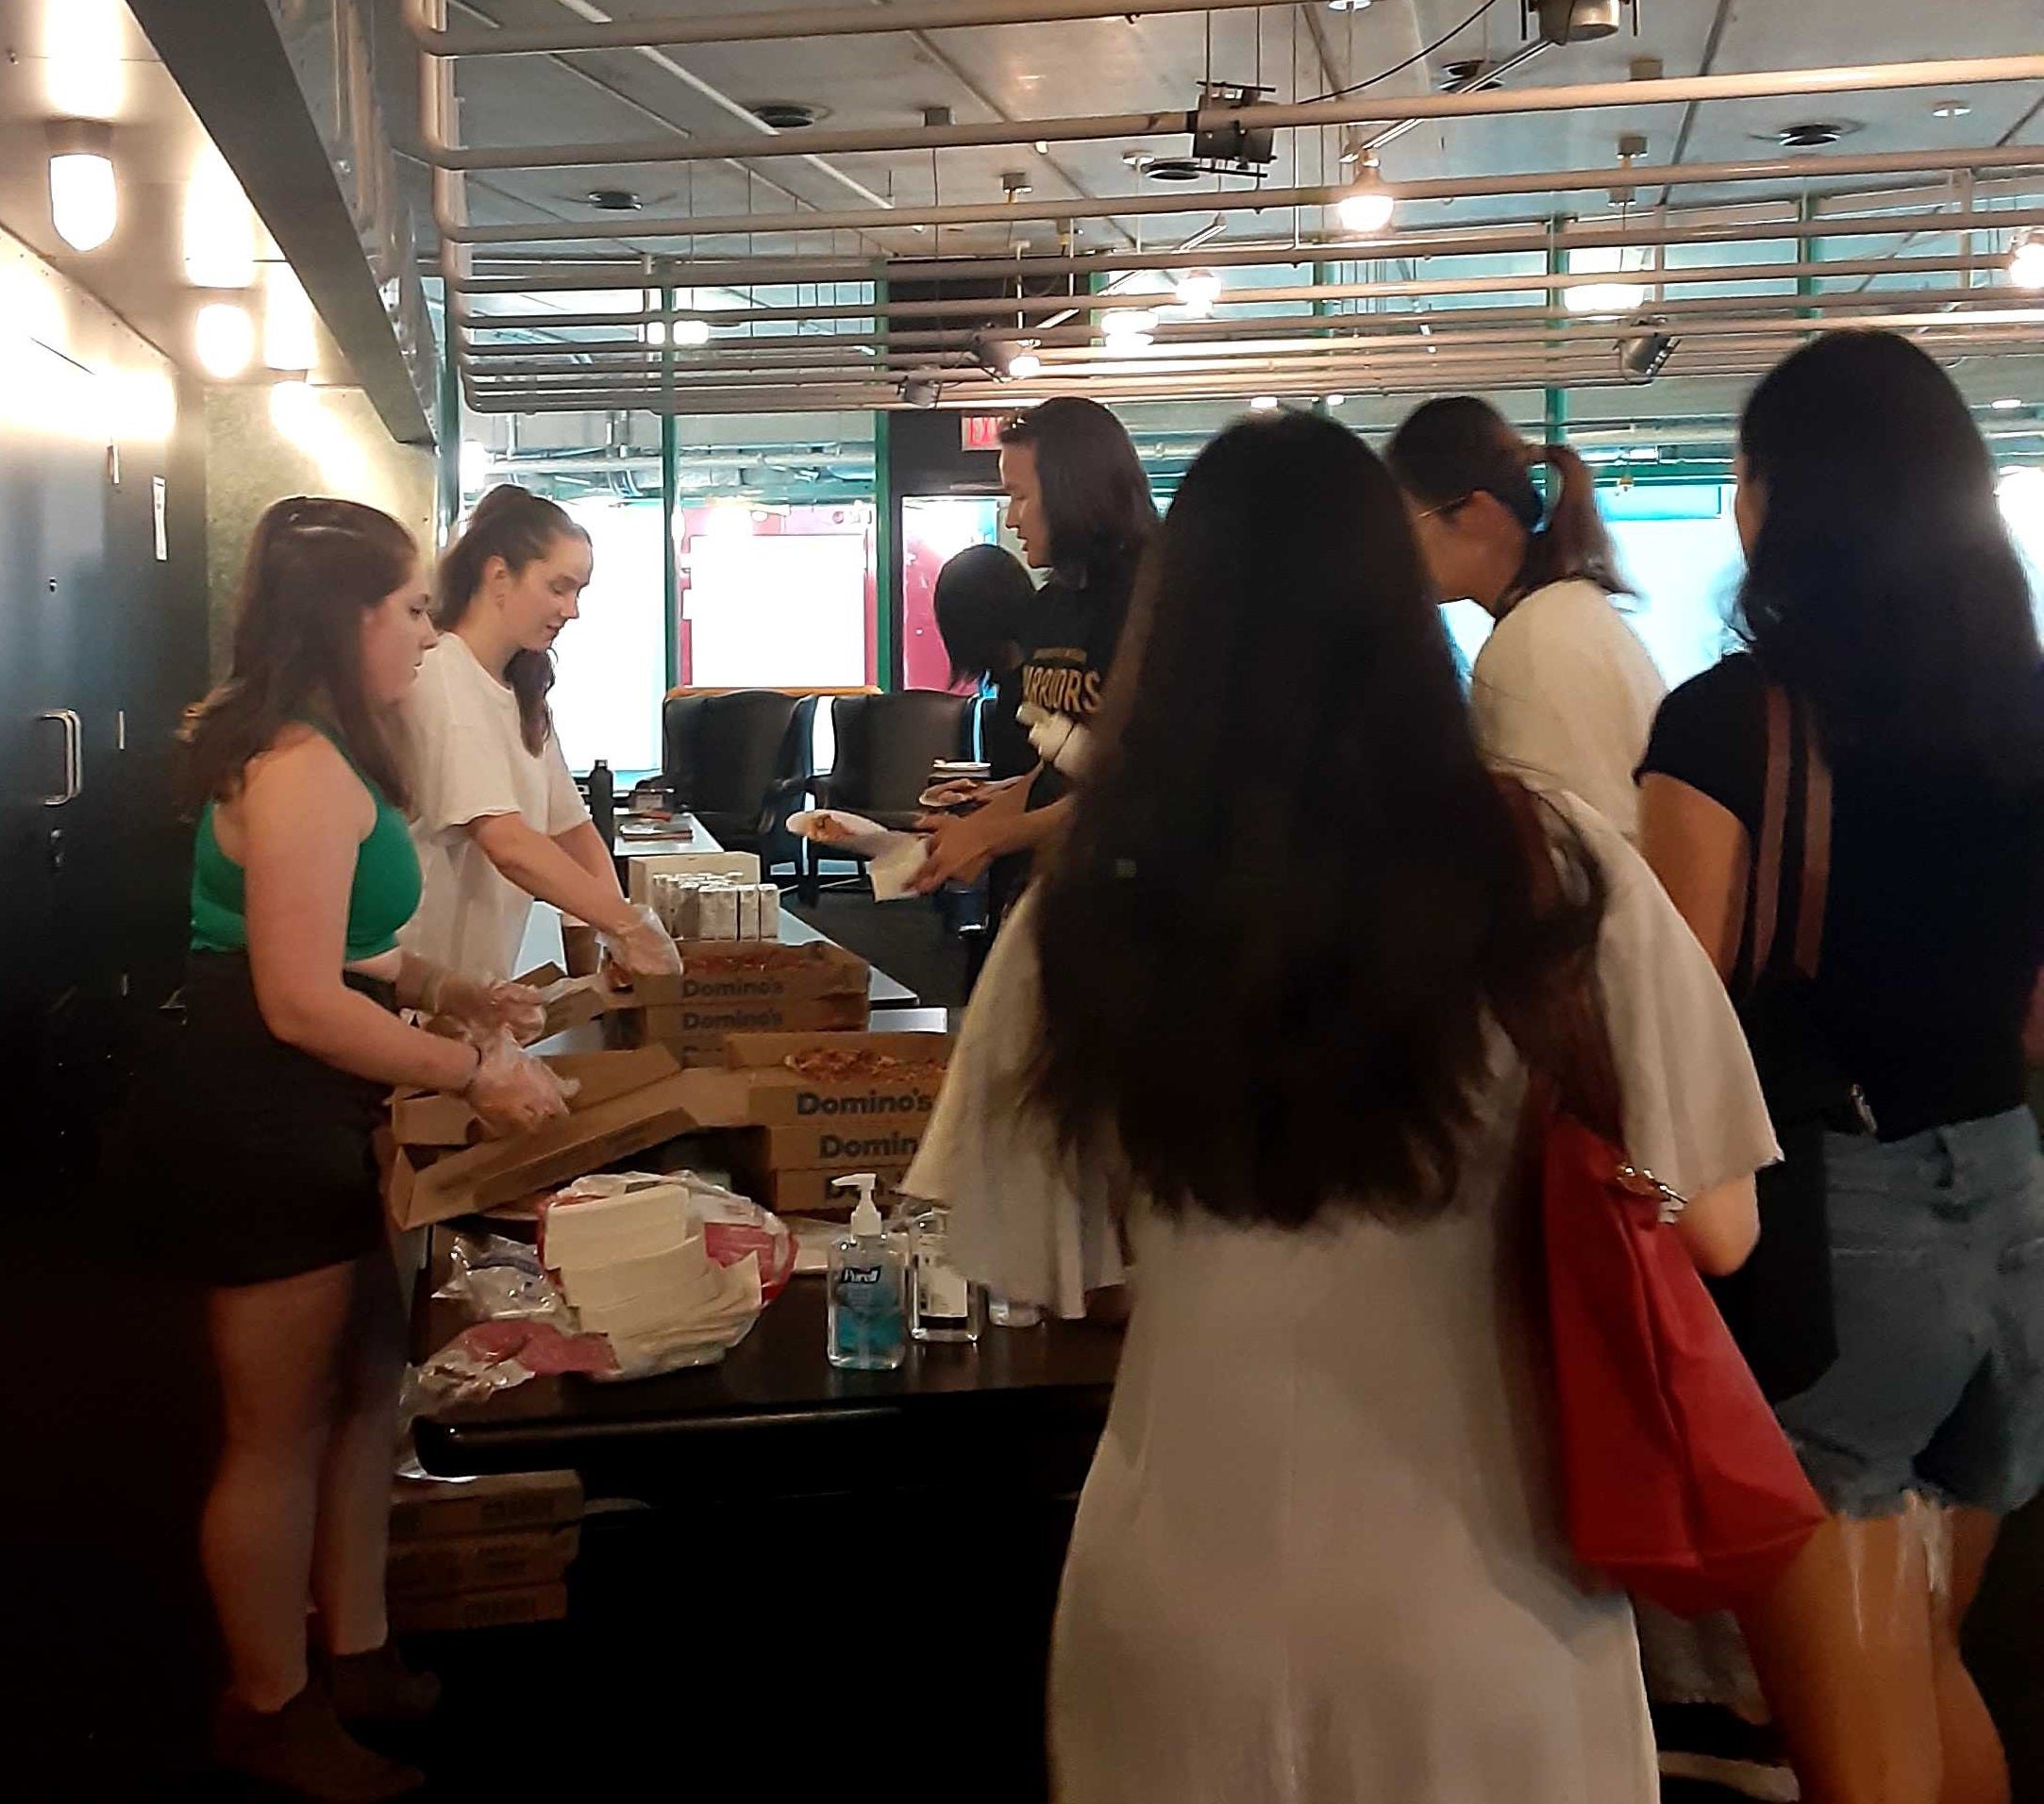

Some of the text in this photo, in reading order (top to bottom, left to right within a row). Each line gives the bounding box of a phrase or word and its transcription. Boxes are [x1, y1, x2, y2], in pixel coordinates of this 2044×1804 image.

[683, 1011, 784, 1031] Domino's
[797, 1089, 932, 1116] Domino's
[819, 1132, 919, 1159] Domin
